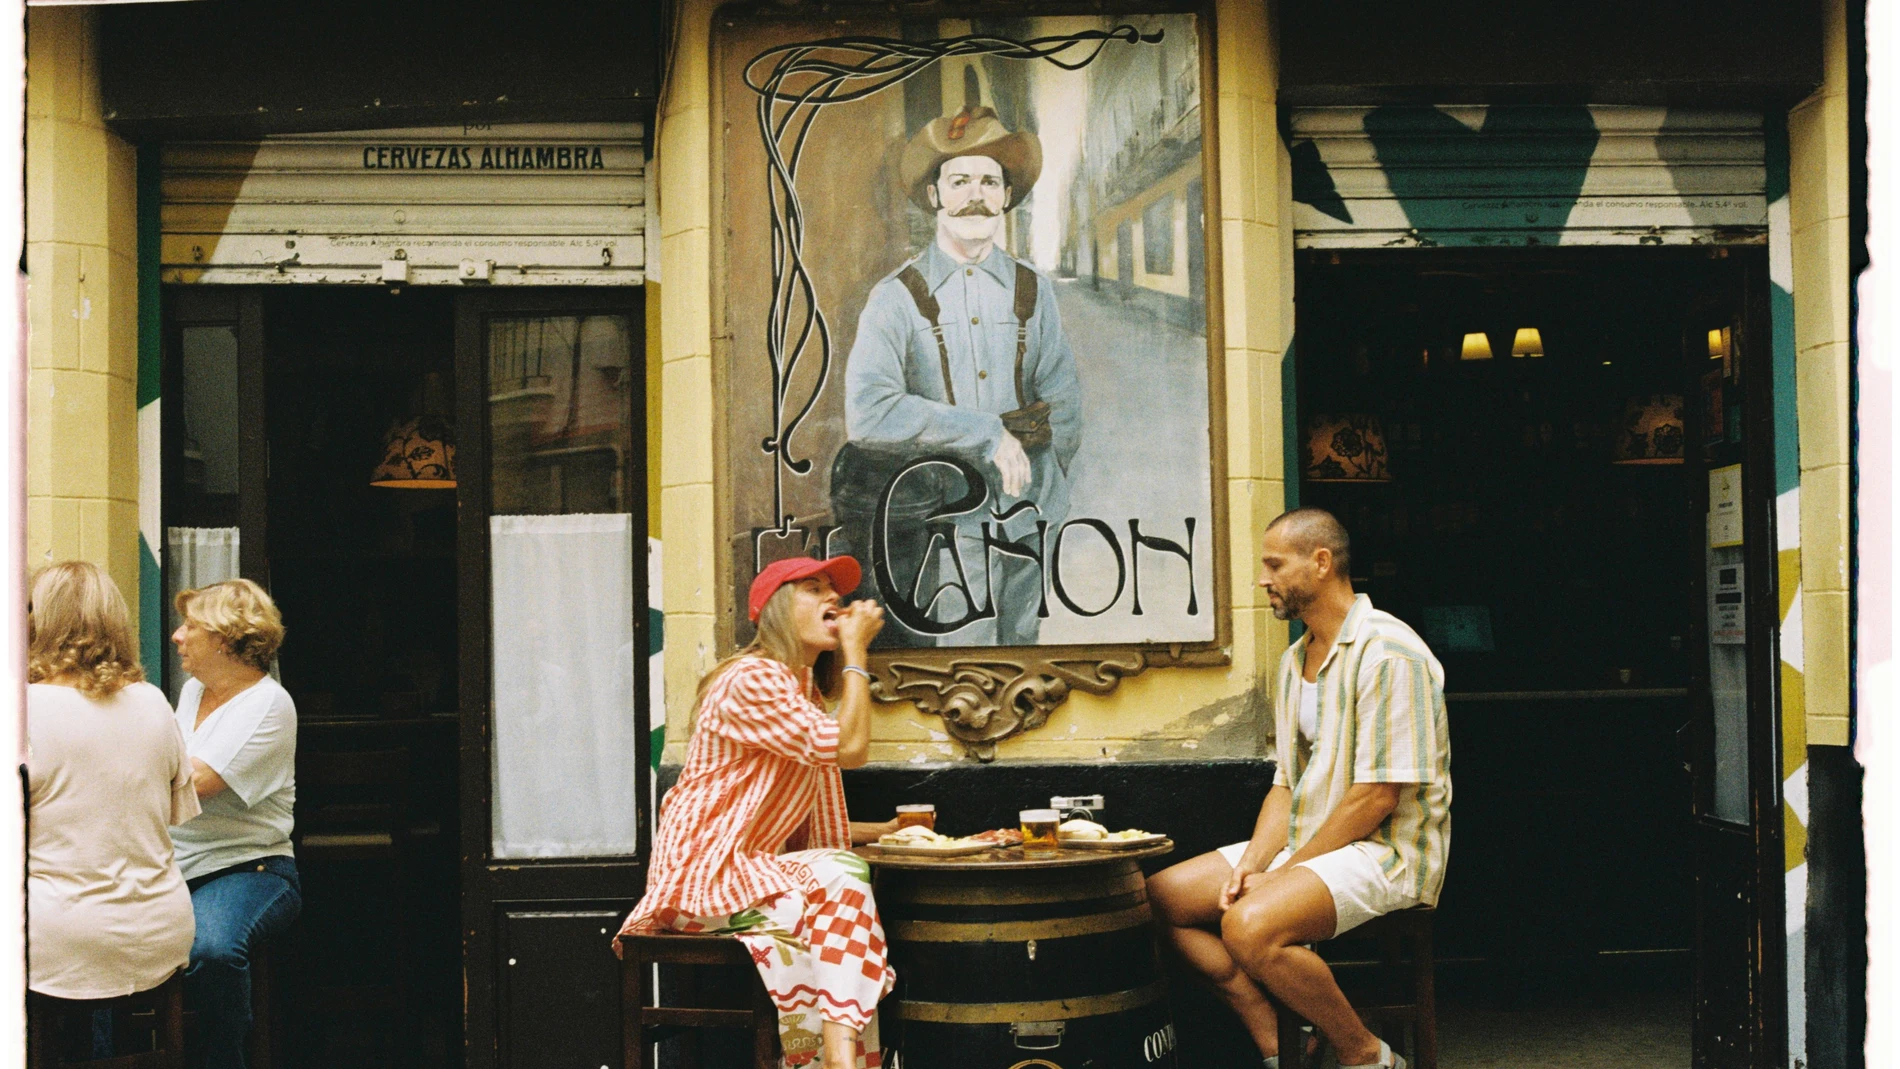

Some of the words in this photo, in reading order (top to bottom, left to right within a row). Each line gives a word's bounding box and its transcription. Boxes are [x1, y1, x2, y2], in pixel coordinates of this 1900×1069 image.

[363, 146, 472, 170] CERVEZAS
[480, 146, 605, 170] ALHAMBRA
[1596, 200, 1604, 208] el
[1605, 201, 1643, 209] consumo
[330, 238, 368, 247] Cervezas
[464, 239, 472, 247] el
[474, 239, 513, 248] consumo
